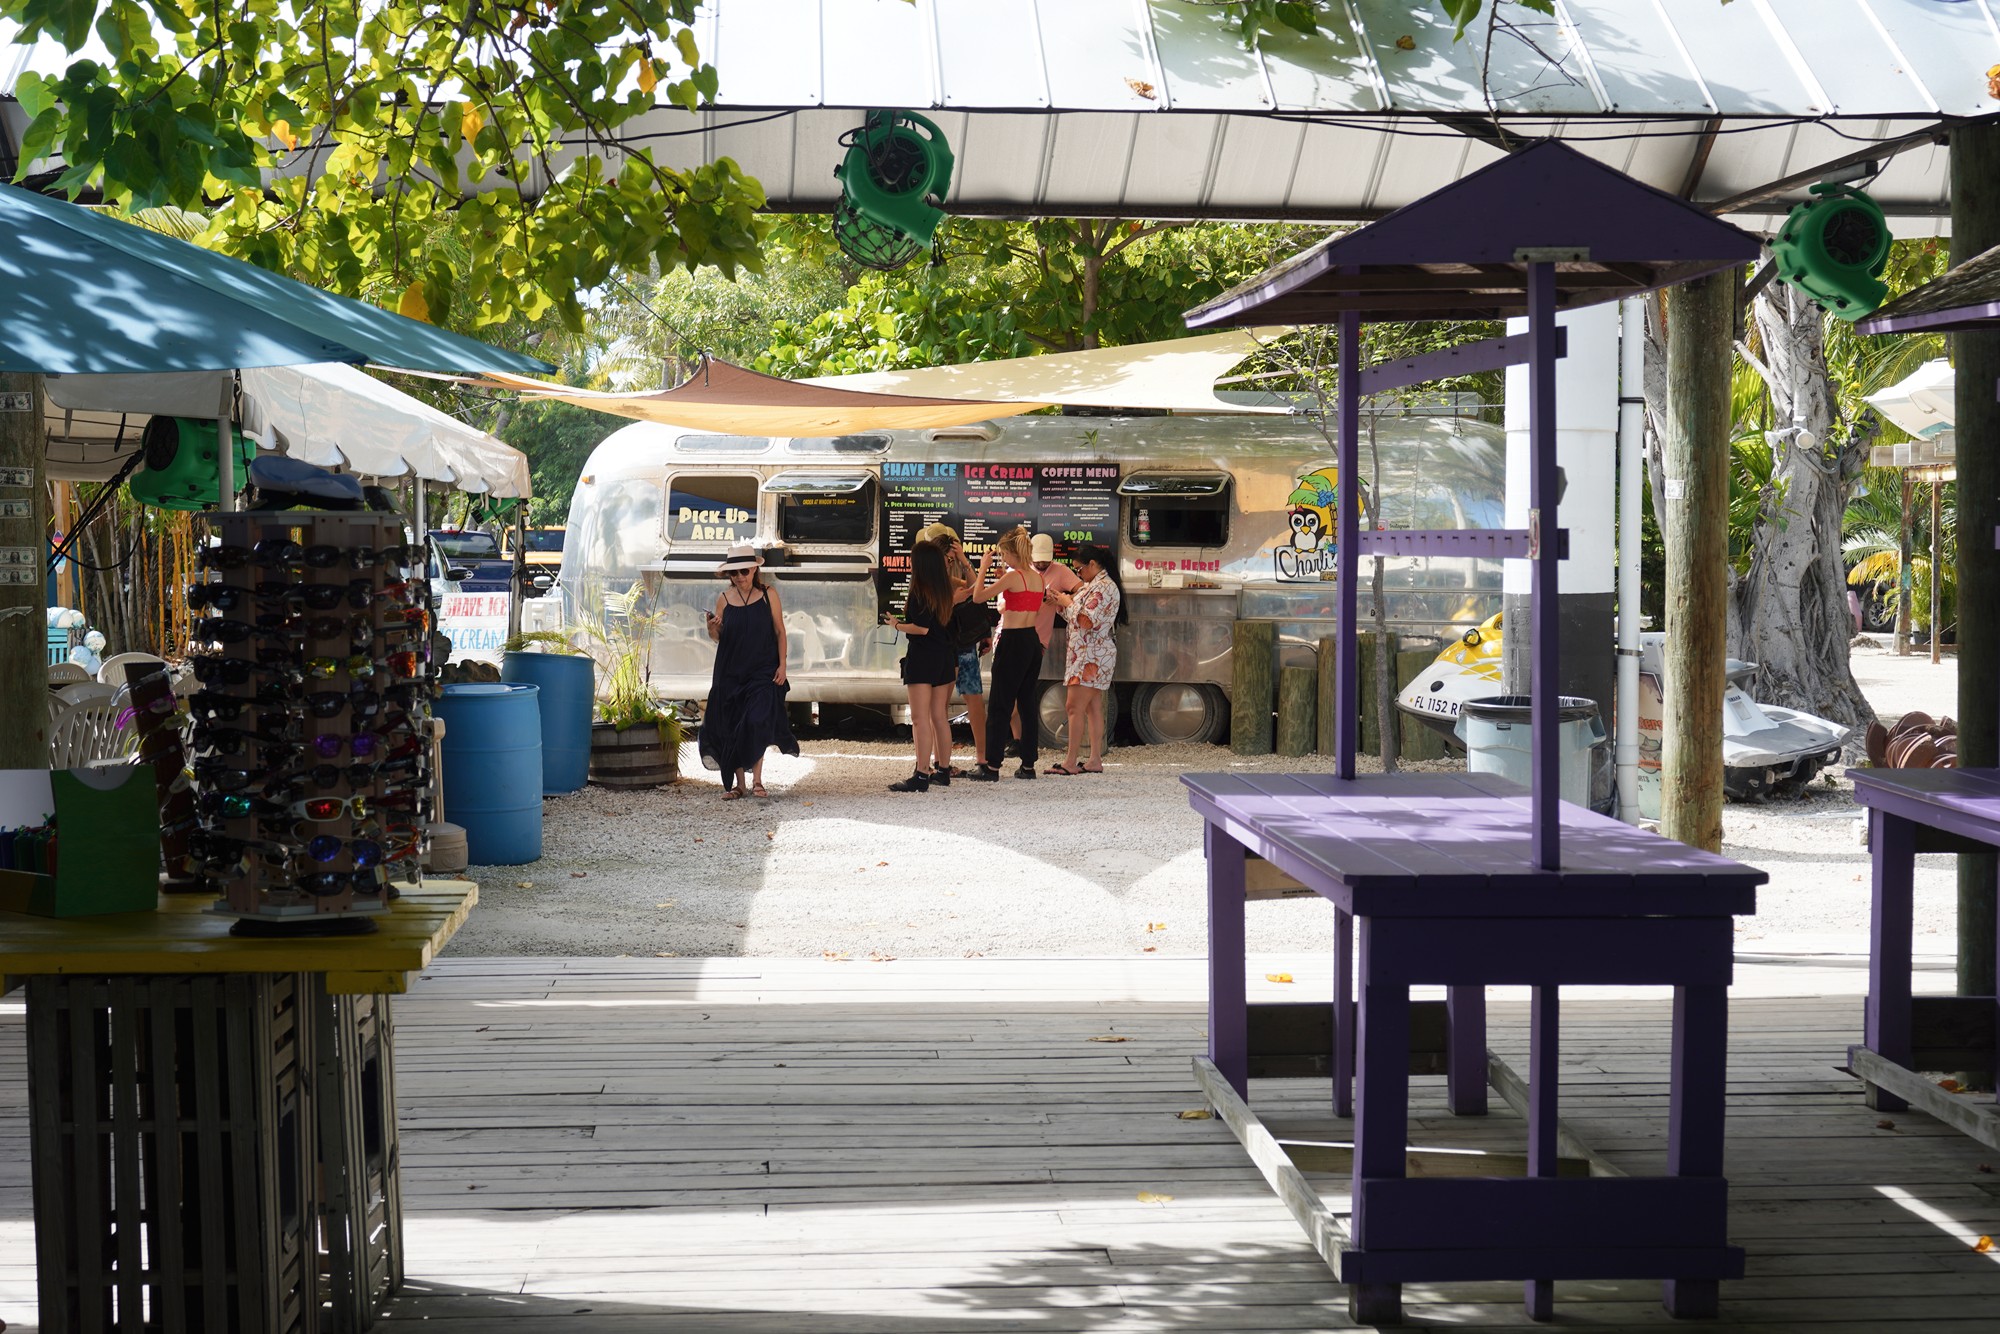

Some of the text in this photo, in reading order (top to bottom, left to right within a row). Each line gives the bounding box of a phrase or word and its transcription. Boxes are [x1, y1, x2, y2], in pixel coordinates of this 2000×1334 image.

[883, 463, 957, 477] SHAVE ICE
[964, 464, 1034, 479] ICE CREAM
[1041, 467, 1117, 478] COFFEE MENU
[679, 507, 749, 524] PICK UP
[691, 524, 735, 540] AREA
[1063, 530, 1093, 541] SODA
[963, 542, 1001, 553] MILKS
[1181, 559, 1220, 571] HERE!
[445, 596, 508, 617] SHAVE ICE
[459, 628, 506, 650] CREAM
[1414, 695, 1424, 709] FL
[1427, 698, 1448, 714] 1152
